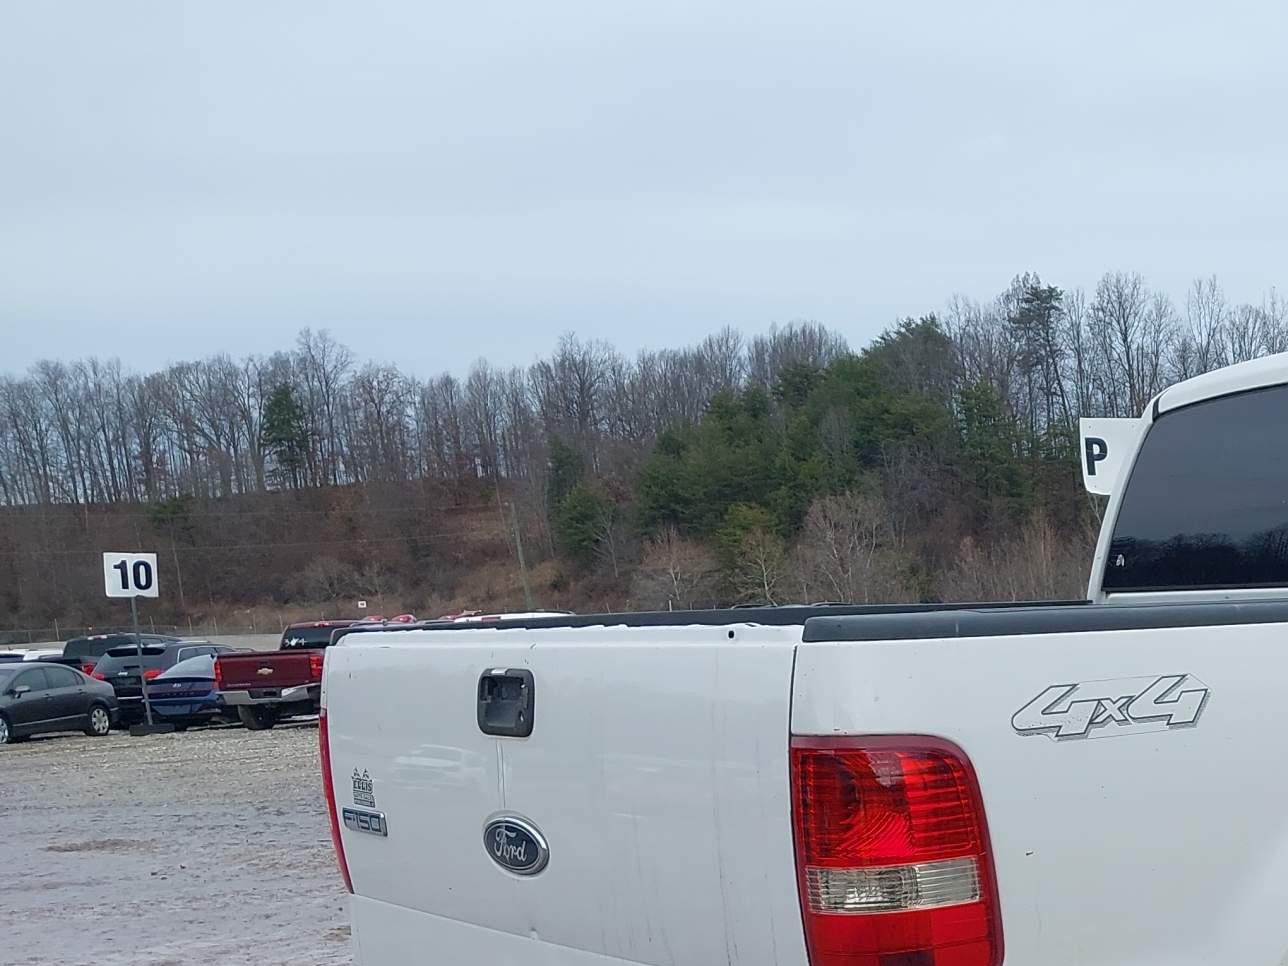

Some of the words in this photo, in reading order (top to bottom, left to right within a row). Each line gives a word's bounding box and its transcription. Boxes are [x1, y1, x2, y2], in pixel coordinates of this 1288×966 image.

[1084, 437, 1108, 476] P
[113, 560, 153, 591] 10
[1011, 674, 1210, 742] 4x4
[353, 780, 373, 792] ELLIS
[494, 828, 527, 862] Ford
